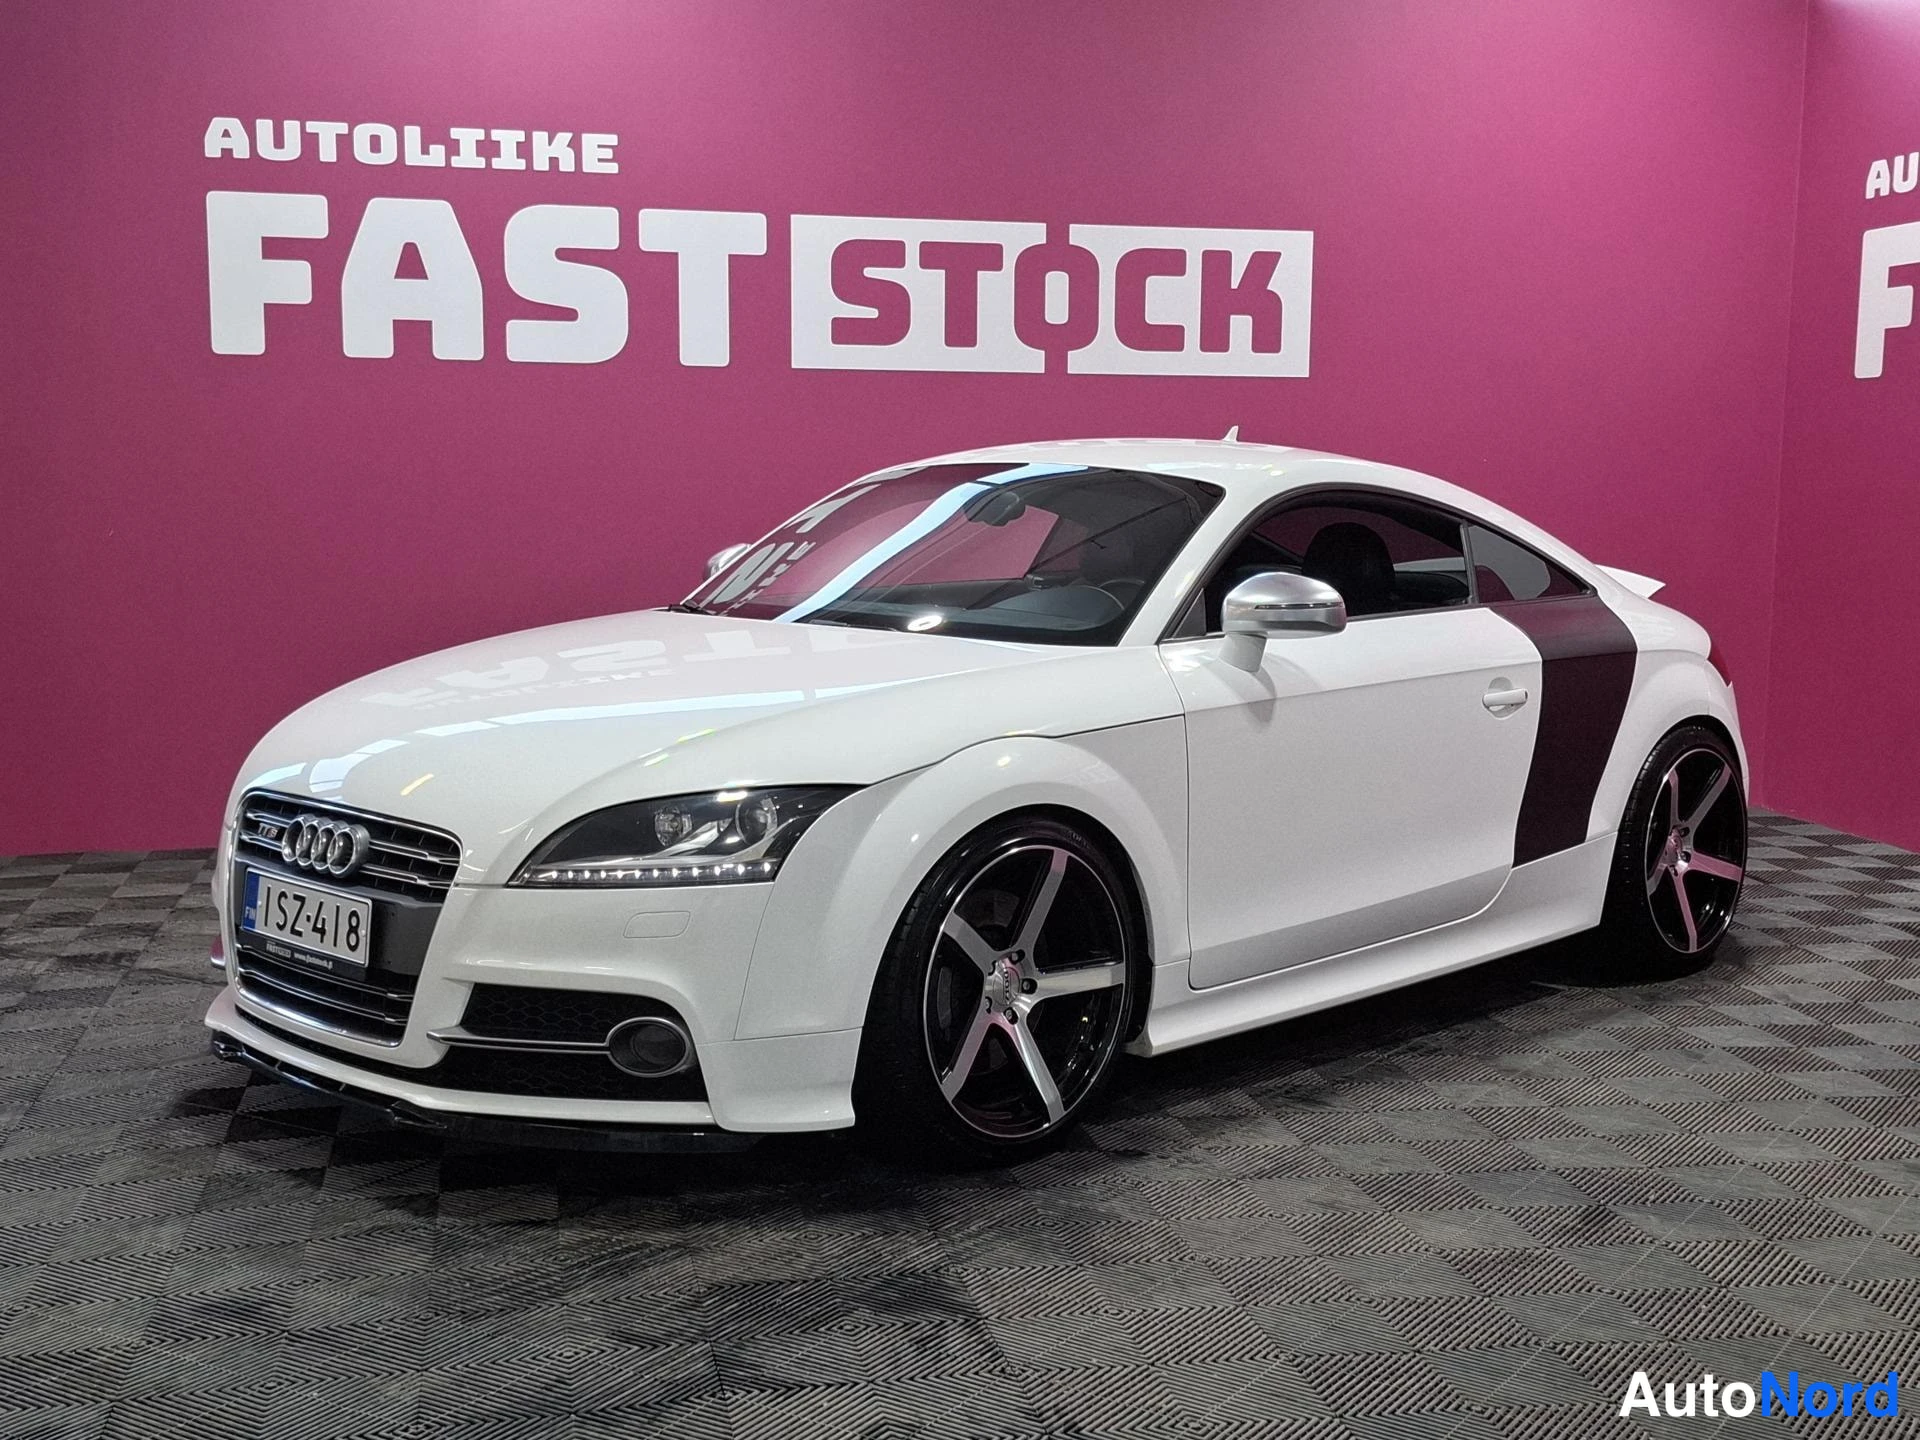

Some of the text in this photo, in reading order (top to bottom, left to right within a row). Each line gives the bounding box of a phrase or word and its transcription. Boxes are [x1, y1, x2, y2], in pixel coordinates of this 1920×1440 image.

[205, 116, 619, 174] AUTOLIIKE
[206, 190, 1284, 368] FAST STOCK
[264, 885, 360, 952] ISZ-418
